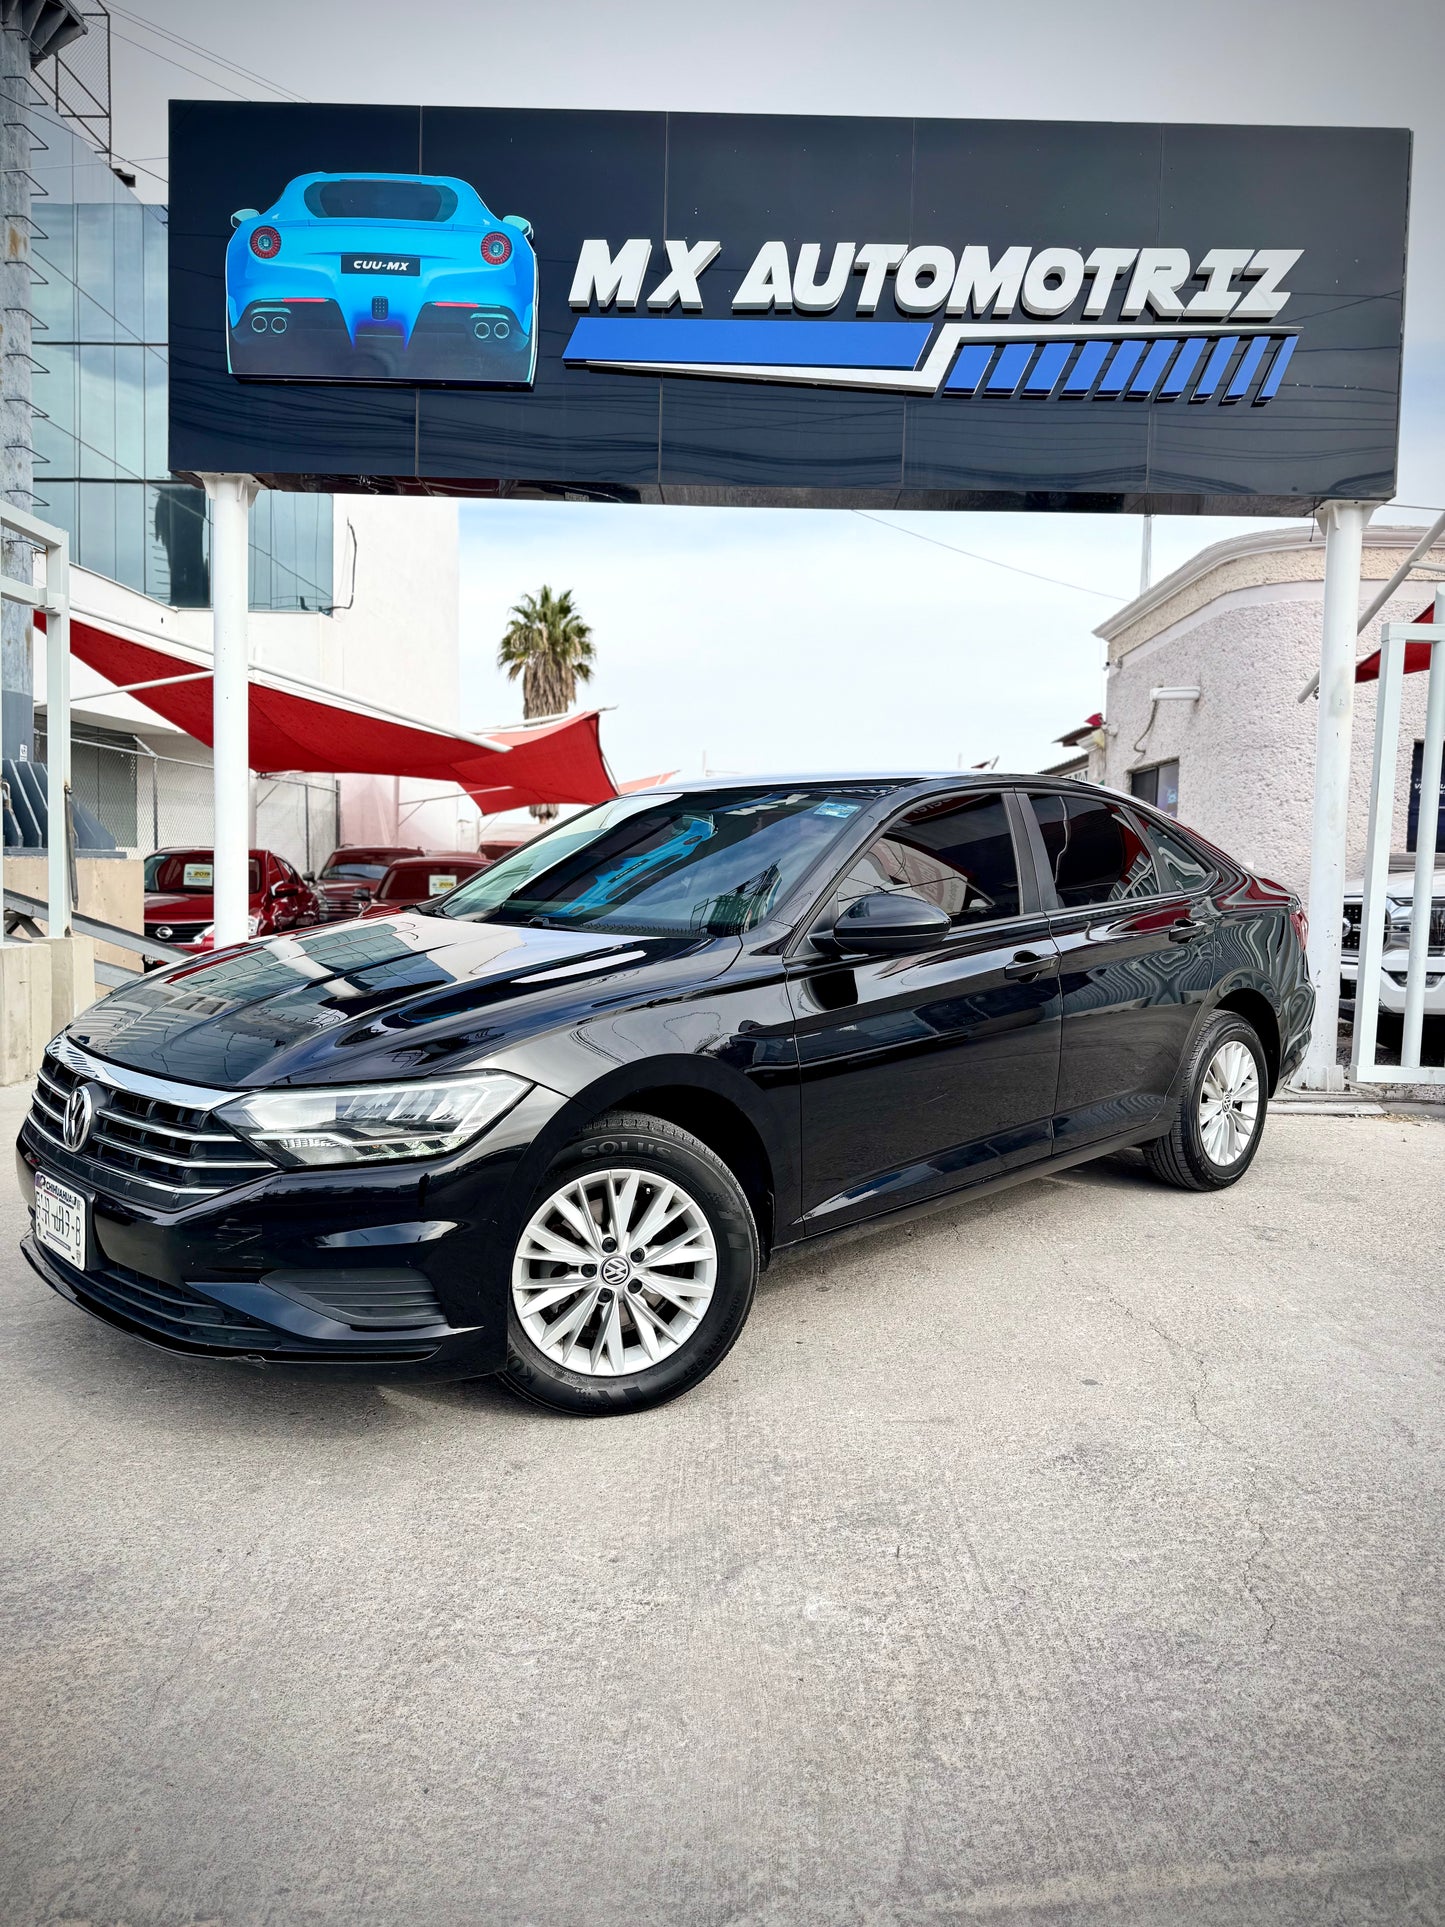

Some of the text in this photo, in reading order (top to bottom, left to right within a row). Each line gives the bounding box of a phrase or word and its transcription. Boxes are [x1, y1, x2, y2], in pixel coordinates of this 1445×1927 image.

[353, 260, 409, 271] CUU-MX
[568, 239, 1305, 318] MX AUTOMOTRIZ
[581, 1141, 671, 1158] SOLUS
[46, 1181, 73, 1203] CHIHUAHUA
